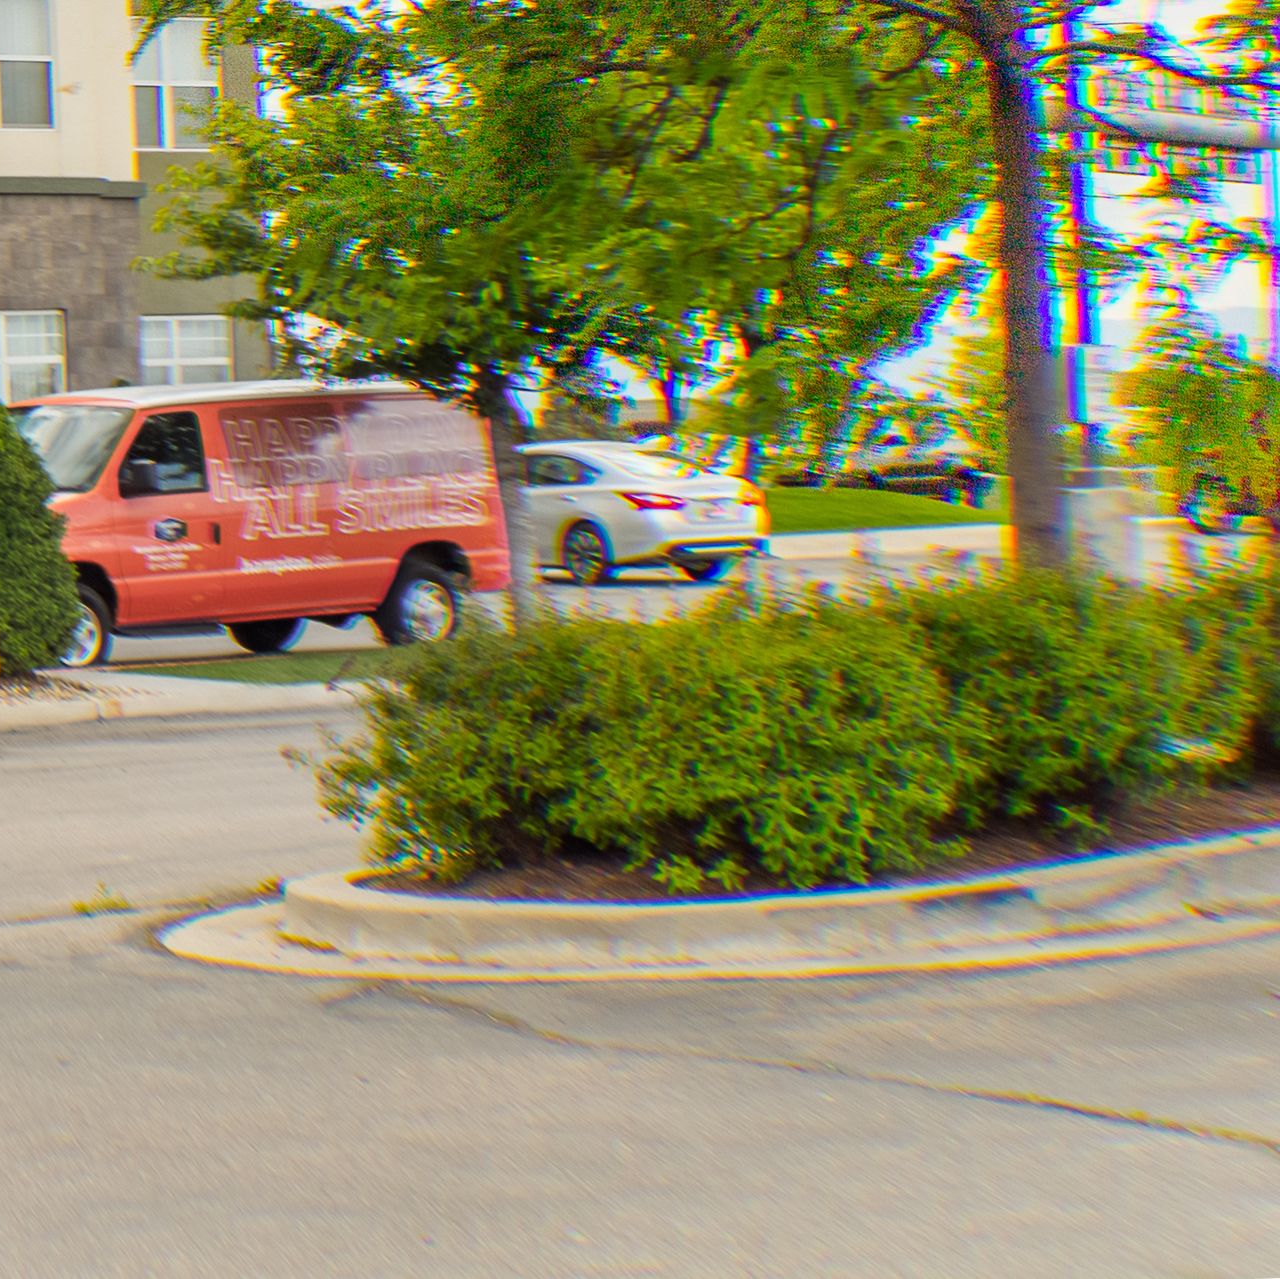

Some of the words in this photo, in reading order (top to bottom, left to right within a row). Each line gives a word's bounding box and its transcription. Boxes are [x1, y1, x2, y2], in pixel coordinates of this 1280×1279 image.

[222, 416, 370, 463] HAPPY
[208, 451, 357, 503] HAPPY
[240, 487, 330, 541] ALL
[333, 484, 491, 535] SMILES
